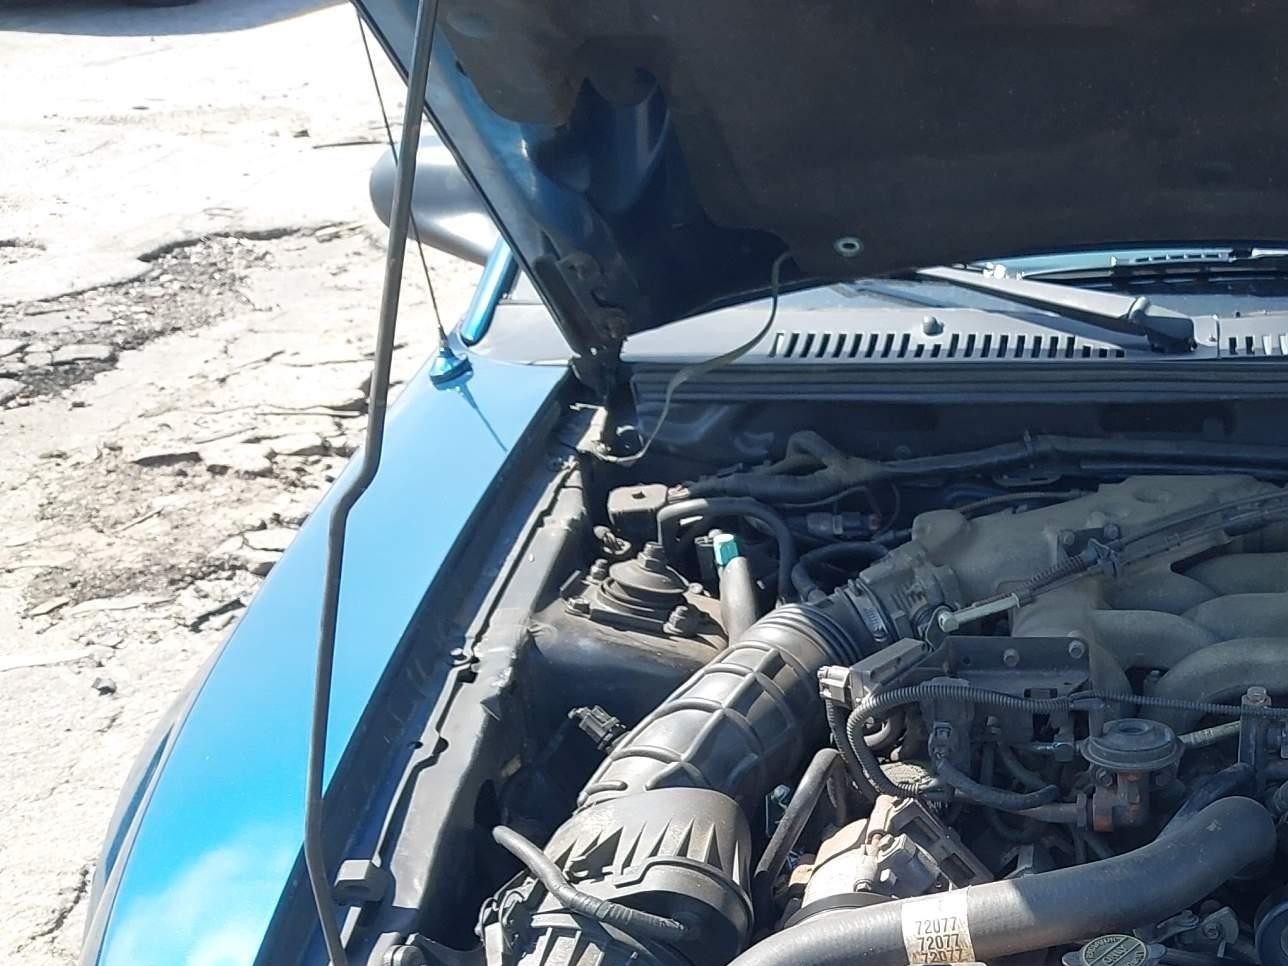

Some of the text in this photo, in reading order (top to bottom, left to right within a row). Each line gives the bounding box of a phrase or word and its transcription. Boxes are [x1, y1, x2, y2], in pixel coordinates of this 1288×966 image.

[915, 916, 957, 935] 72077
[917, 933, 960, 952] 72077
[921, 949, 963, 964] 72077
